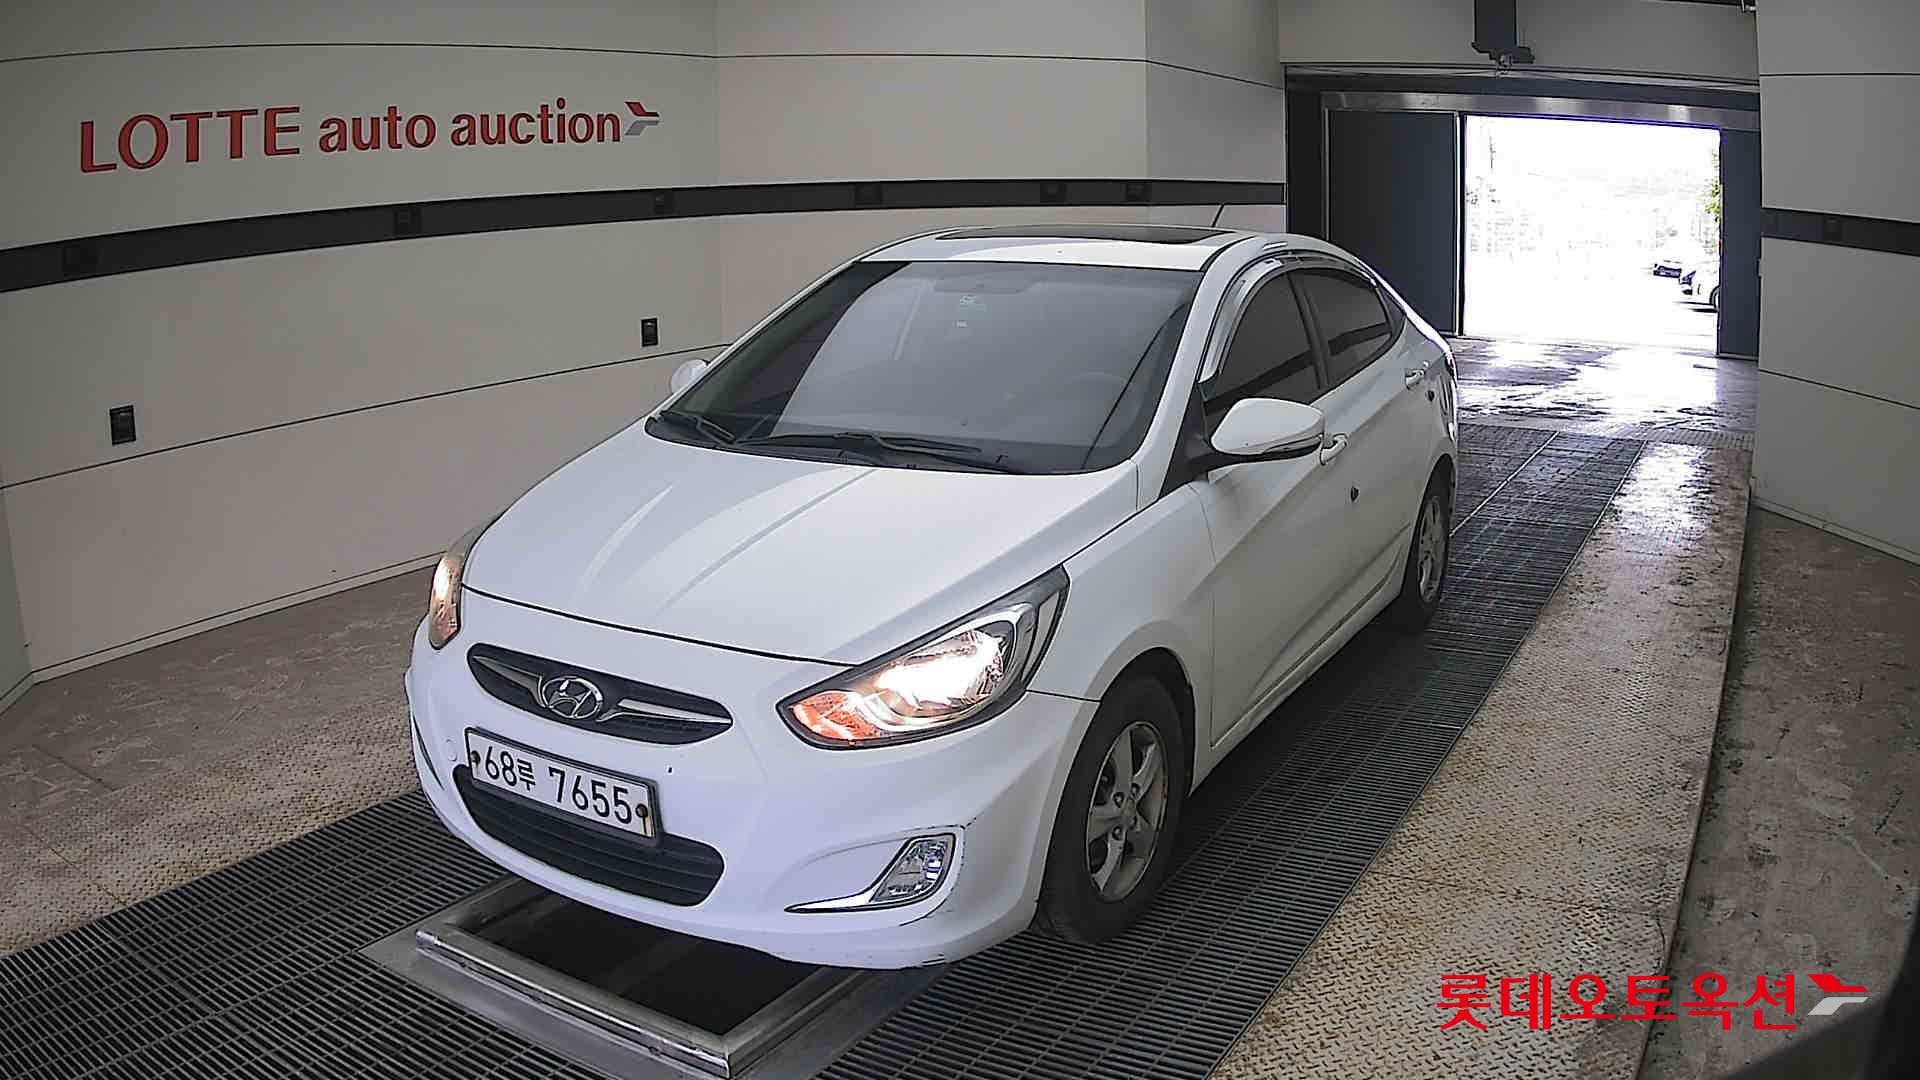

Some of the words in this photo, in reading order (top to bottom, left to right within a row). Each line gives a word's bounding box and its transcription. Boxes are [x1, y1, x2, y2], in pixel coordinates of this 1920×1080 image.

[80, 106, 300, 173] LOTTE
[318, 105, 437, 153] auto
[450, 97, 622, 147] auction
[485, 746, 536, 791] 68루
[548, 766, 632, 824] 7655
